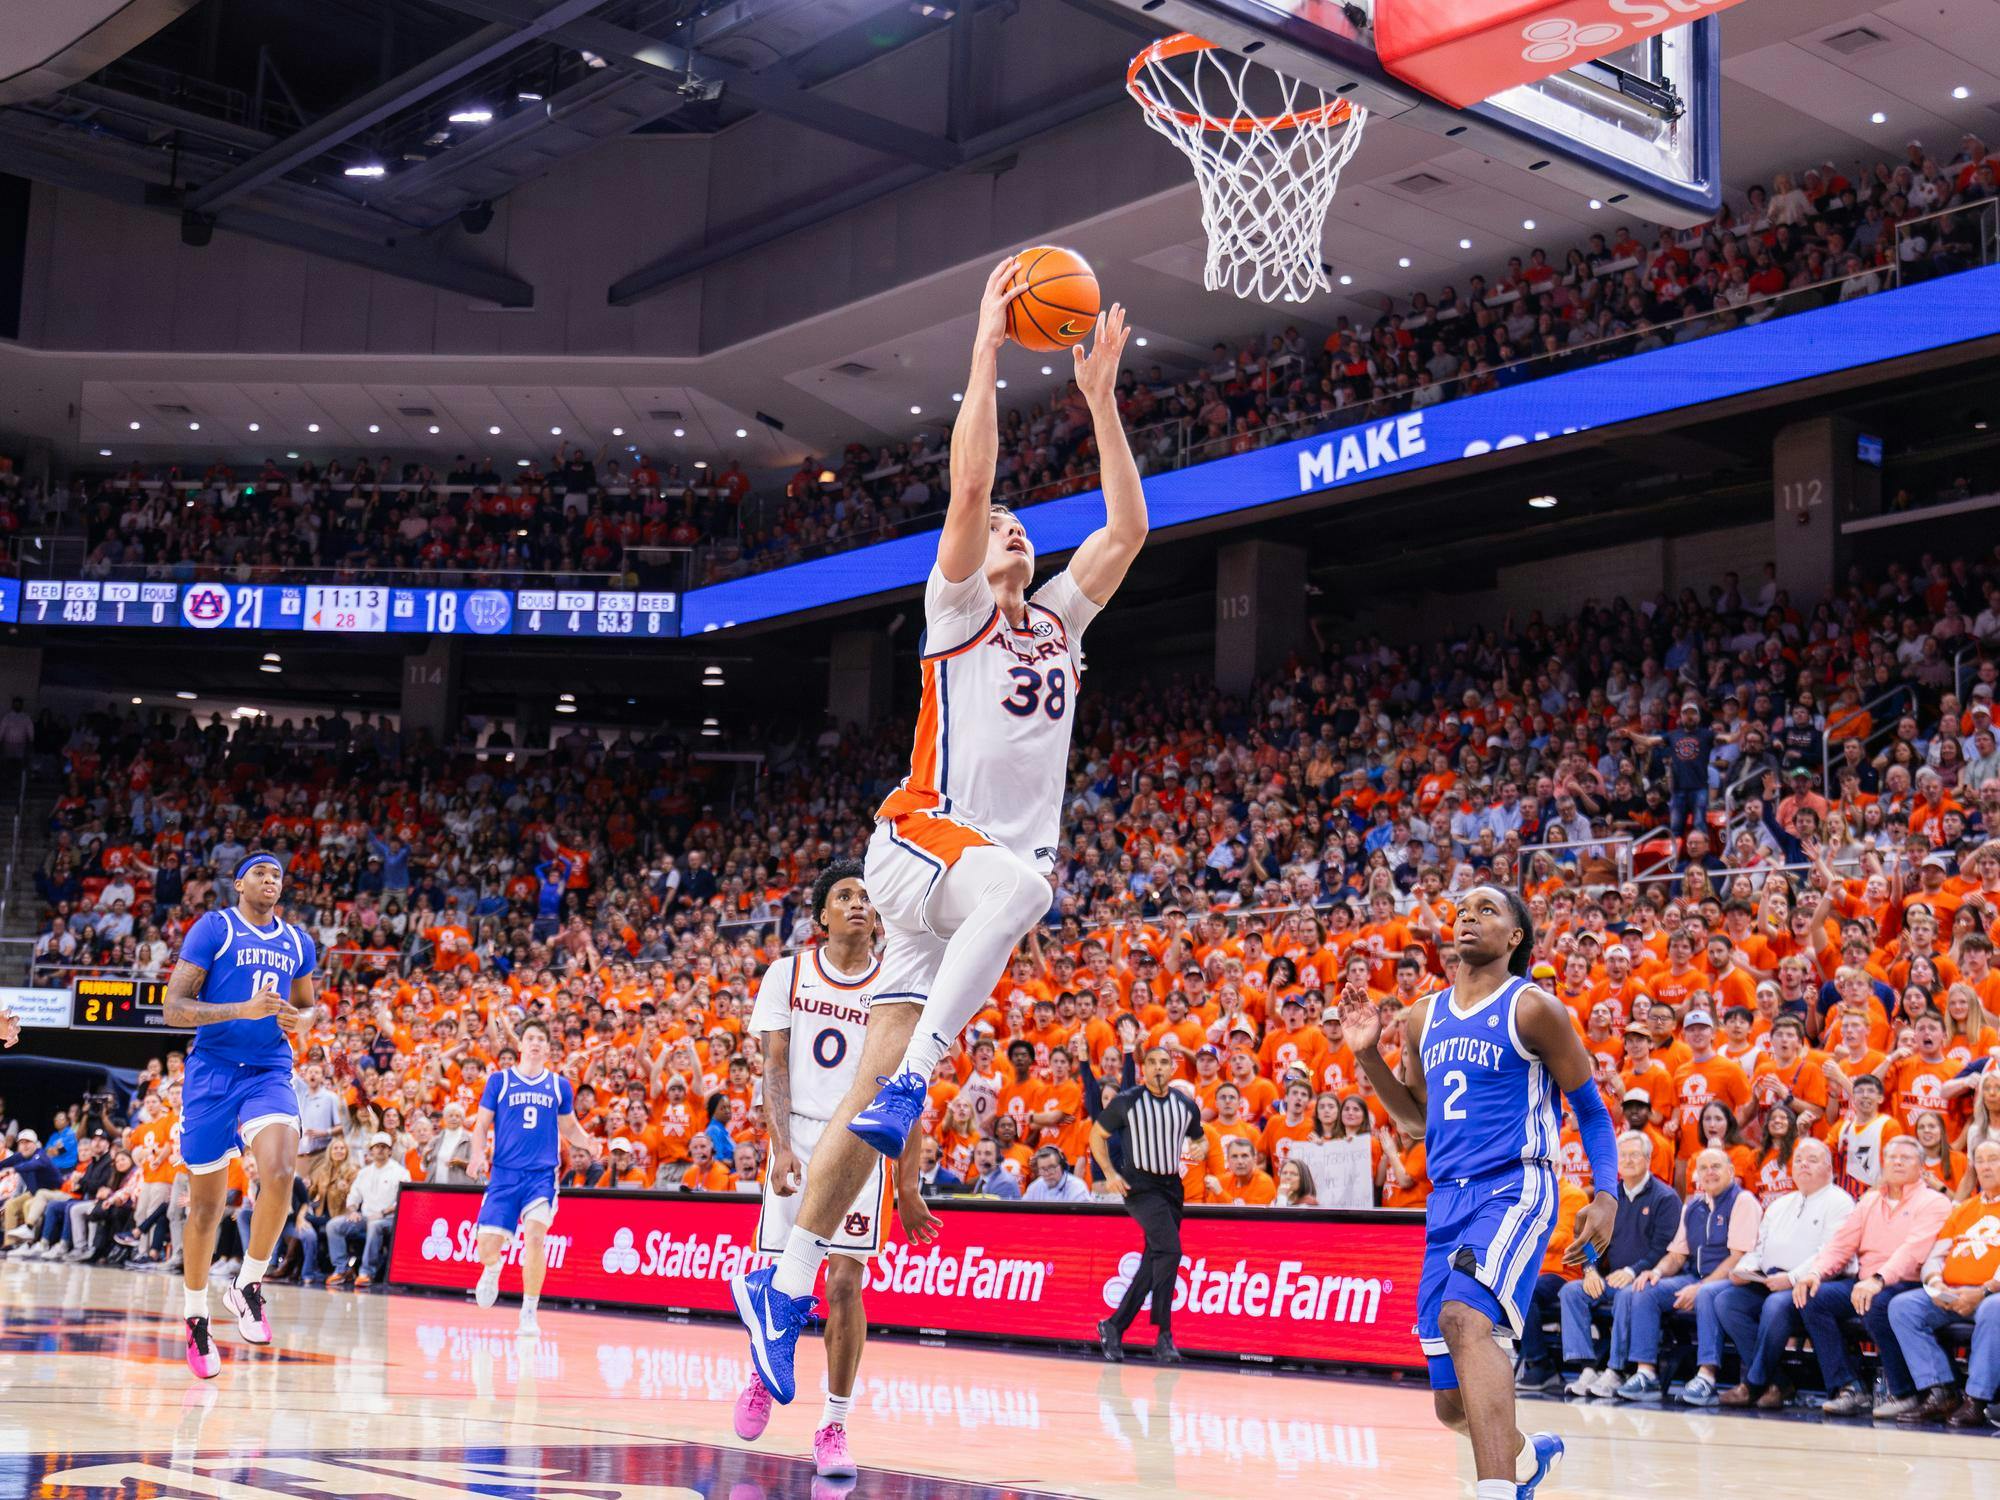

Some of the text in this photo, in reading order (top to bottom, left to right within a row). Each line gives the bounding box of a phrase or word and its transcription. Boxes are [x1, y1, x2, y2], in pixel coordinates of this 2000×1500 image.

[1298, 411, 1426, 491] MAKE
[1783, 479, 1823, 510] 112
[31, 585, 59, 597] REB
[112, 587, 131, 599] TO
[143, 588, 175, 600] FOULS
[317, 590, 379, 608] 11:13
[521, 595, 551, 608] FOULS
[37, 601, 48, 621] 7
[63, 600, 97, 622] 43.8
[117, 602, 125, 623] 1
[235, 588, 264, 629] 21
[425, 591, 458, 633] 18
[566, 596, 585, 608] TO
[641, 598, 669, 609] REB
[1222, 595, 1249, 619] 113
[336, 614, 356, 628] 28
[529, 610, 541, 632] 4
[568, 611, 580, 632] 4
[597, 612, 633, 633] 53.3
[648, 612, 660, 633] 8
[1001, 666, 1066, 720] 38
[236, 948, 296, 976] KENTUCKY
[85, 999, 114, 1022] 21
[813, 1026, 847, 1069] 0
[1424, 1037, 1504, 1072] KENTUCKY
[508, 1091, 554, 1109] KENTUCKY
[1443, 1070, 1468, 1121] 2
[523, 1106, 538, 1129] 9
